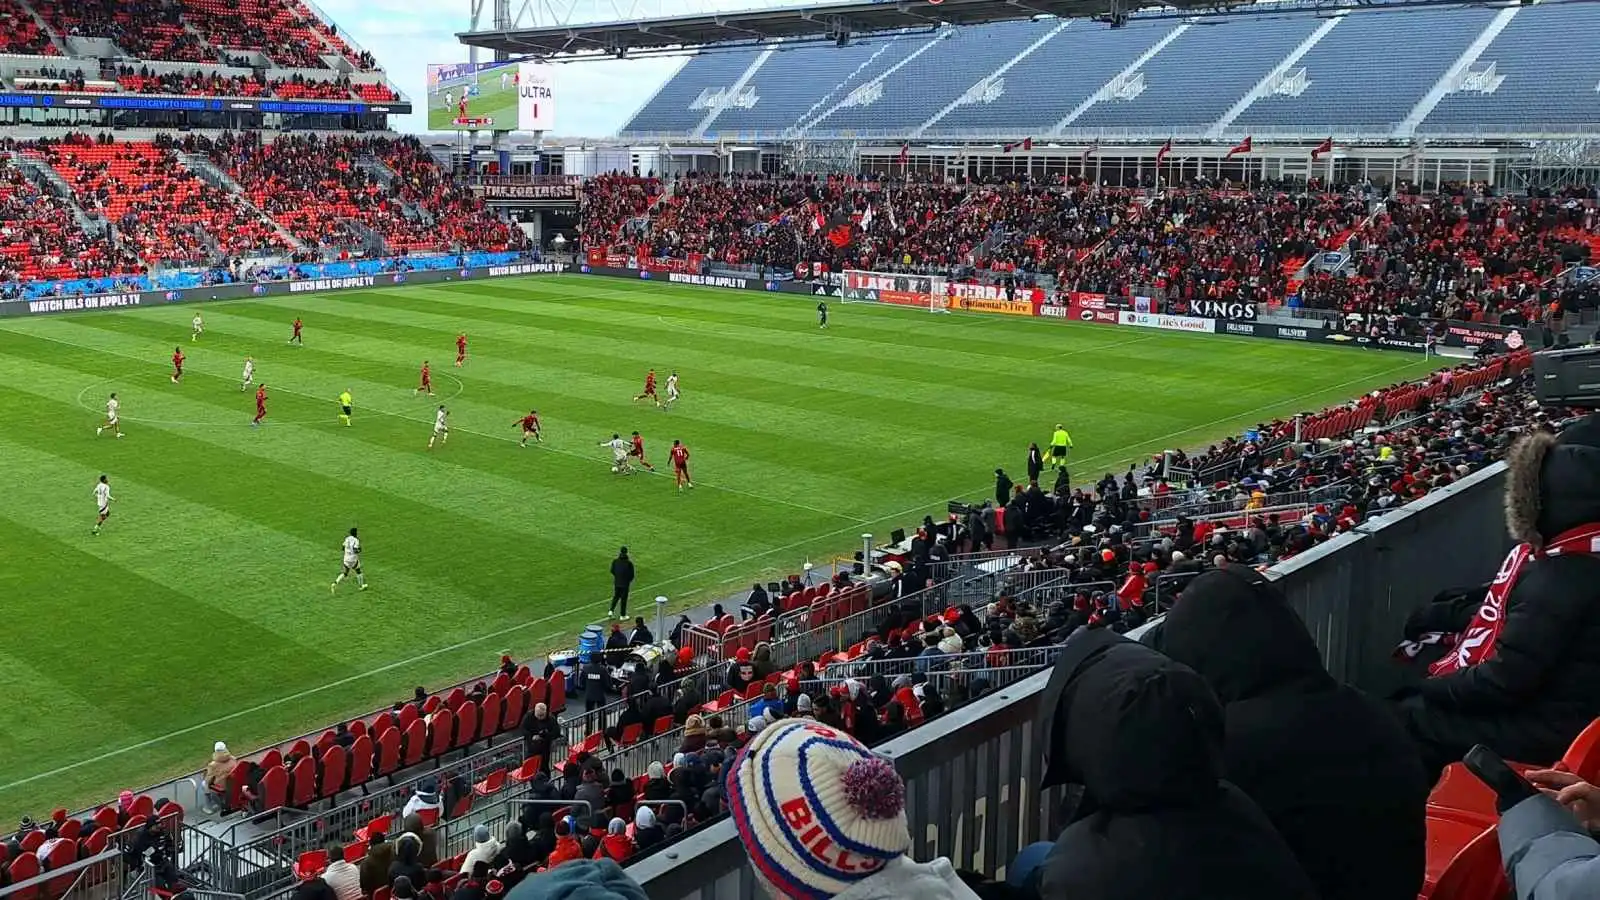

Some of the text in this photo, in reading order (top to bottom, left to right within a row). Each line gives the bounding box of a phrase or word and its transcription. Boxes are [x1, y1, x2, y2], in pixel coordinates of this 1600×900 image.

[520, 86, 552, 99] ULTRA
[510, 185, 573, 197] FORTRESS
[489, 265, 509, 277] WATCH
[531, 263, 553, 273] APPLE
[554, 263, 564, 272] TV
[290, 281, 315, 292] WATCH
[316, 280, 330, 290] MLS
[343, 277, 364, 288] APPLE
[365, 276, 374, 286] TV
[669, 272, 691, 283] WATCH
[715, 277, 736, 288] APPLE
[737, 279, 747, 289] TV
[29, 293, 141, 313] WATCH MLS ON APPLE TV
[1190, 299, 1256, 320] KINGS
[1137, 315, 1149, 323] LG
[780, 796, 878, 871] BILLS
